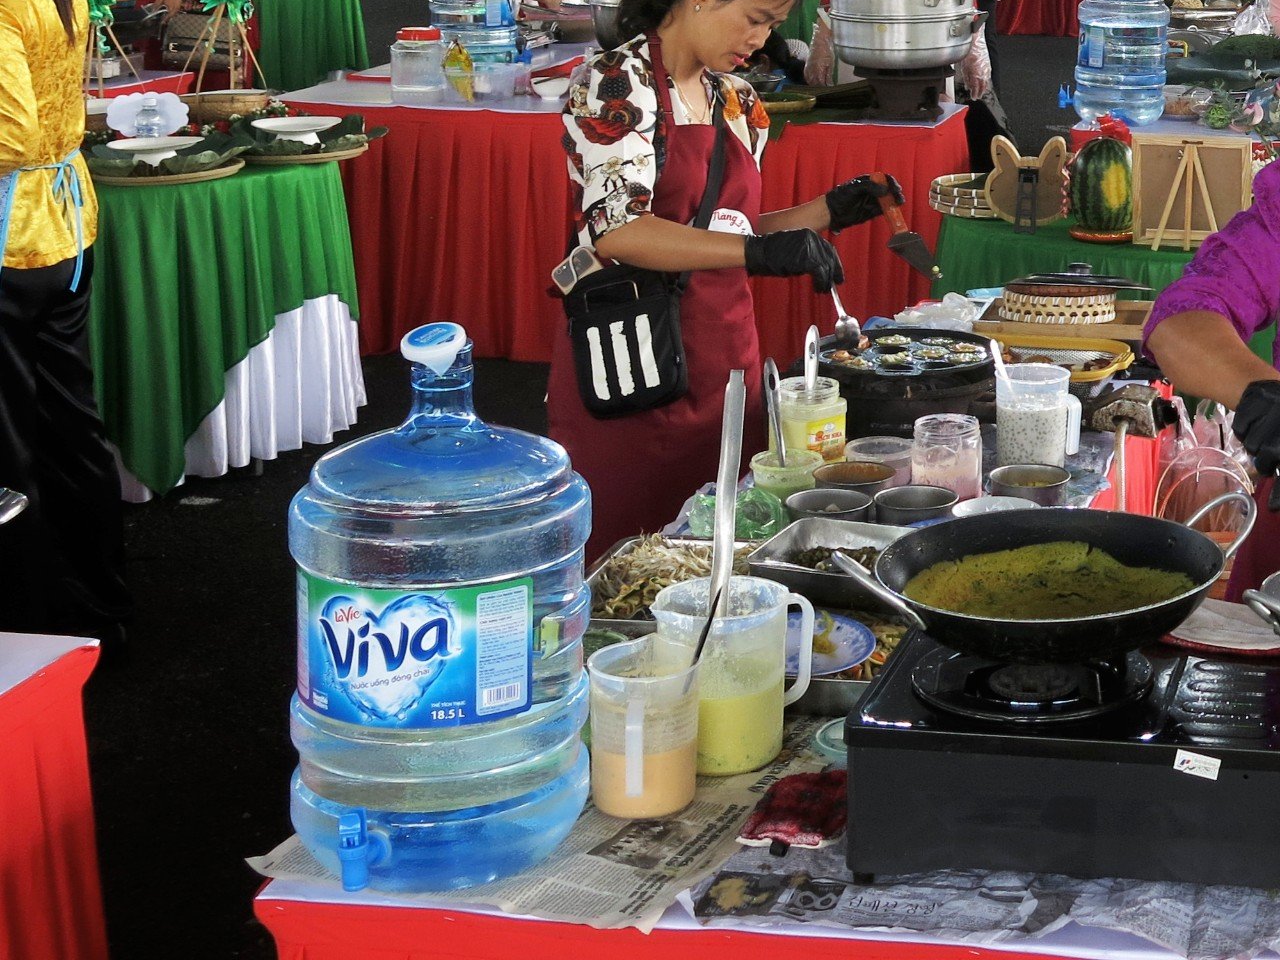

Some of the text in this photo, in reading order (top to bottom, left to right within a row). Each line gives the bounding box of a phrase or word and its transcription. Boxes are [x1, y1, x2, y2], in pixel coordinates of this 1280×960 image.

[713, 211, 740, 228] Nàng
[413, 666, 430, 678] chai
[430, 709, 466, 720] 18.5 L
